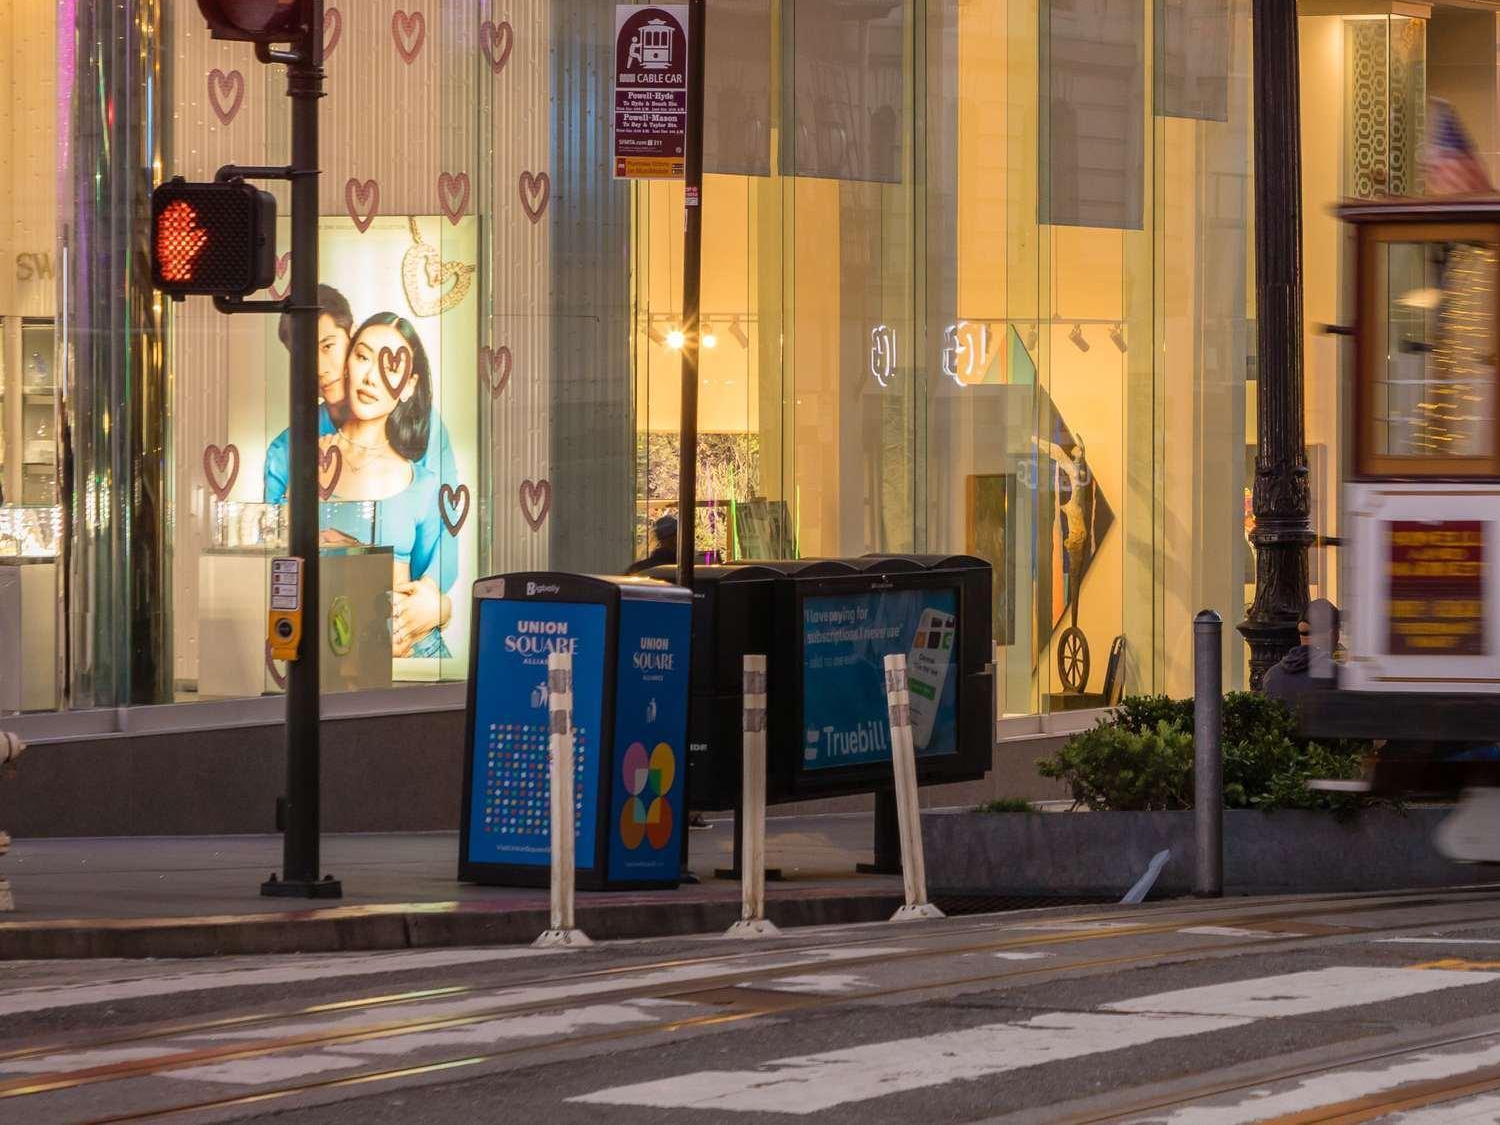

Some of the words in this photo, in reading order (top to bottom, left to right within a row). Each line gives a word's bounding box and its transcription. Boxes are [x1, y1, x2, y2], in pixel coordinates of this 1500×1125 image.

[636, 73, 664, 84] CABLE
[664, 73, 683, 85] CAR
[627, 91, 674, 101] Powell-Hyde
[623, 113, 678, 123] Powell-Mason
[517, 620, 569, 635] UNION
[503, 634, 580, 657] SQUARE
[639, 637, 669, 650] UNION
[522, 657, 549, 665] ALLIA
[632, 650, 674, 673] SQUARE
[823, 719, 887, 758] Truebill
